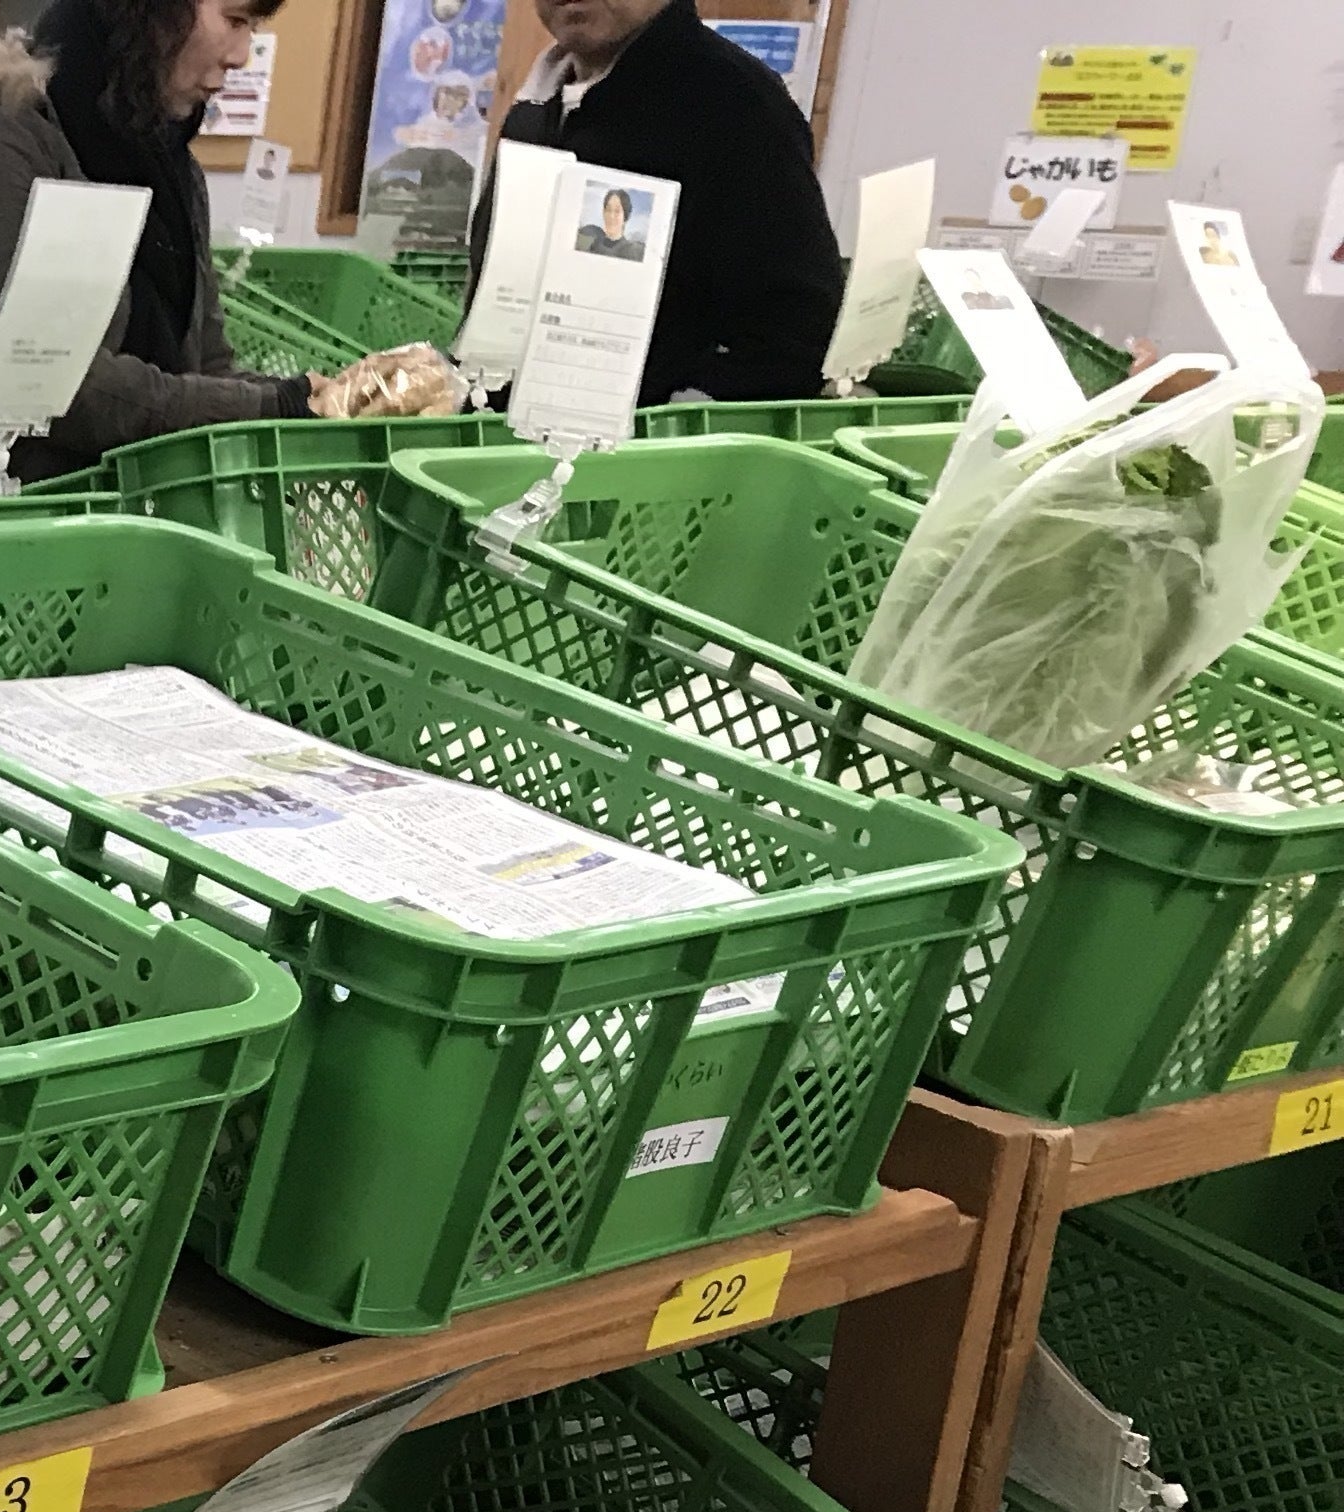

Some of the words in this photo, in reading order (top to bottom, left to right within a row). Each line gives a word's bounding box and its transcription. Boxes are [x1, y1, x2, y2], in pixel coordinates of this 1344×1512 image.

[1004, 155, 1119, 183] じゃがいも
[1301, 1094, 1333, 1136] 21
[691, 1273, 748, 1326] 22
